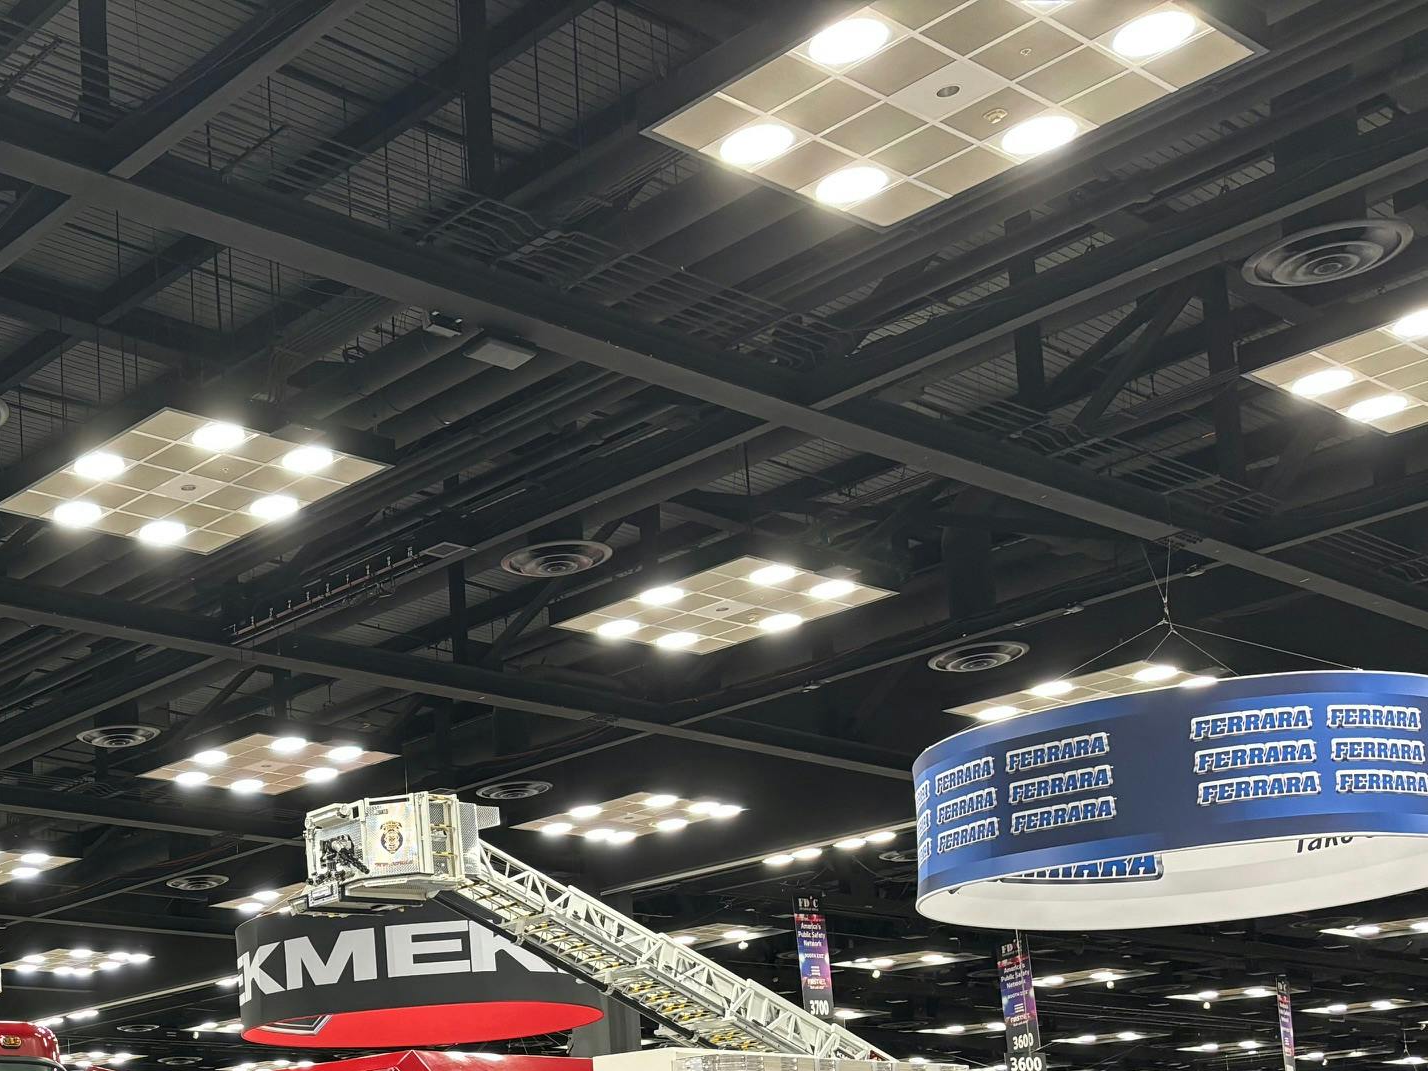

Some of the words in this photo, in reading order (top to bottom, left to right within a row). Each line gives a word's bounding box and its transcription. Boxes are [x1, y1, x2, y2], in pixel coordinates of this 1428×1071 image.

[1194, 709, 1309, 739] FERRARA
[1329, 708, 1420, 729] FERRARA
[1007, 734, 1108, 773] FERRARA
[1198, 743, 1314, 773] FERRARA
[1334, 741, 1424, 762] FERRARA
[936, 759, 992, 794] FERRARA
[1011, 767, 1112, 803] FERRARA
[1202, 774, 1318, 804] FERRARA
[1338, 773, 1428, 793] FERRARA
[938, 790, 995, 824] FERRARA
[1012, 798, 1116, 834] FERRARA
[939, 820, 997, 853] FERRARA
[809, 1000, 829, 1015] 3700
[1012, 1032, 1034, 1050] 3600
[1009, 1056, 1043, 1071] 3600
